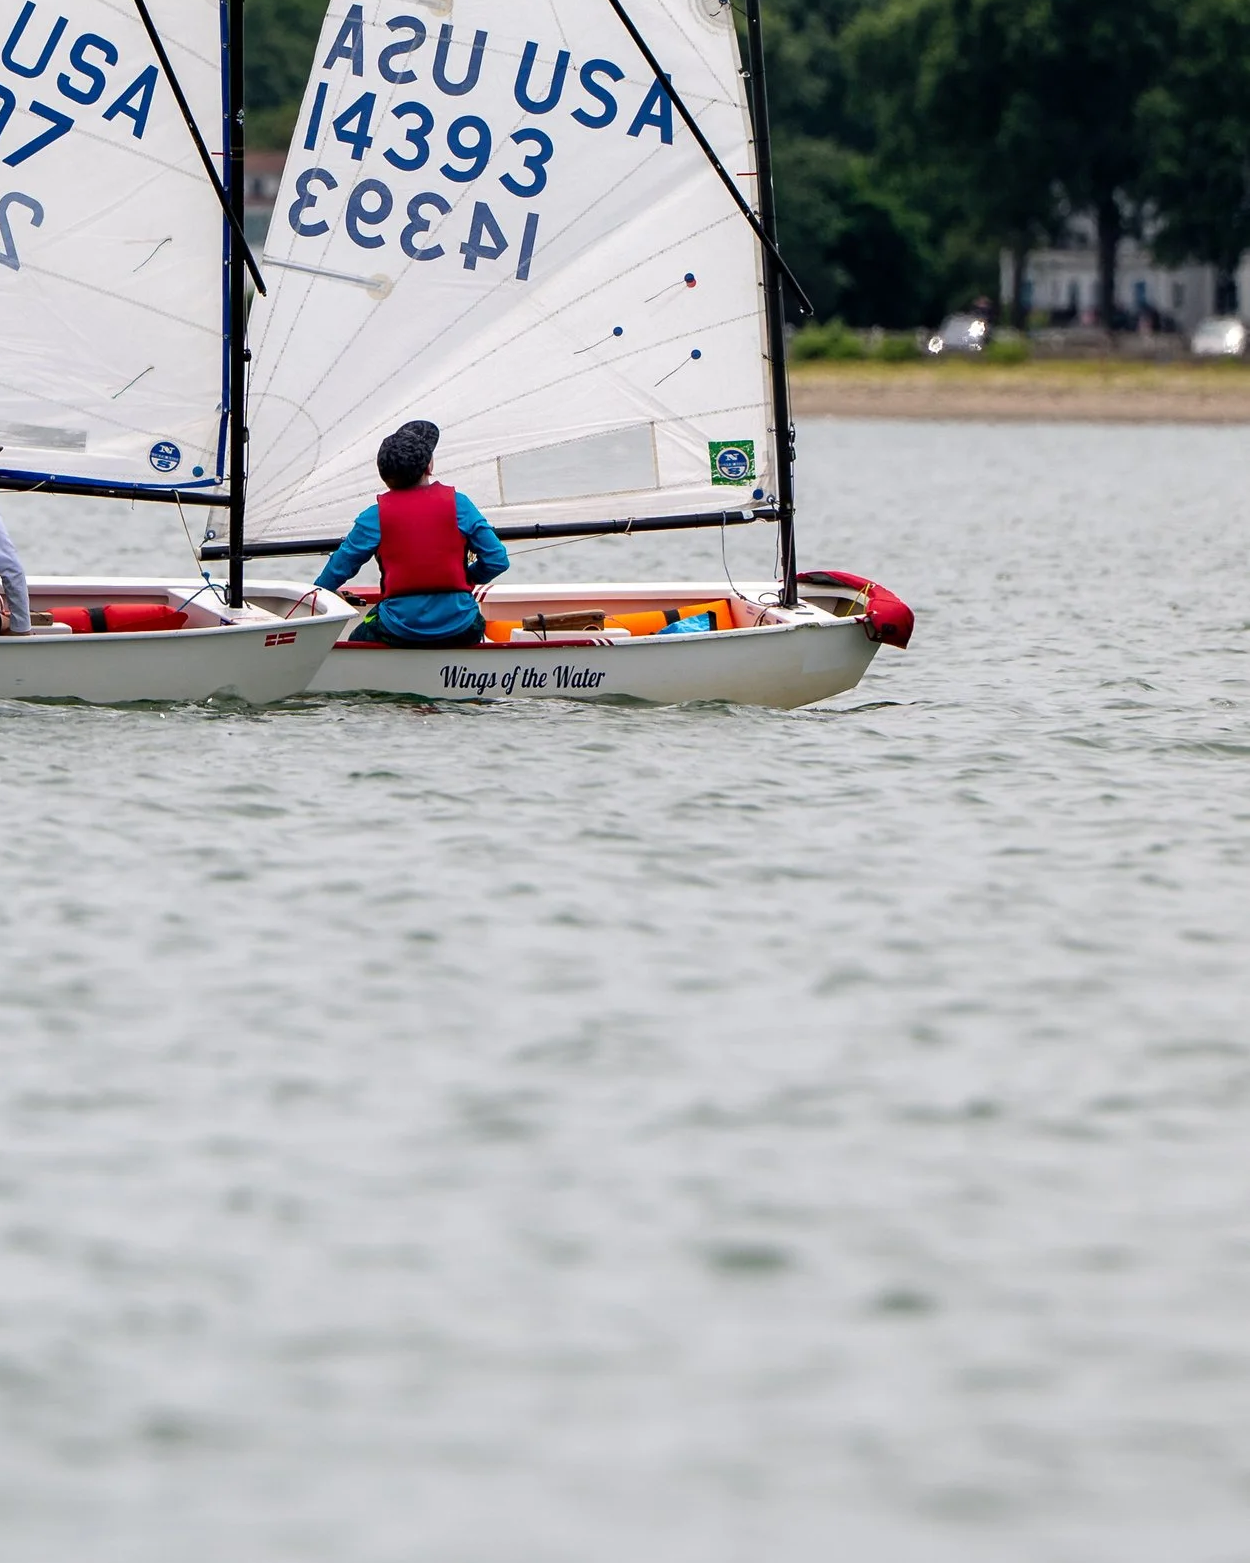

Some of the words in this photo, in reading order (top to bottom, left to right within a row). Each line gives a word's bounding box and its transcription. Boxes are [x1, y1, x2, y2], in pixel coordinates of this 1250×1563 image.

[1, 0, 160, 140] USA
[514, 40, 674, 146] USA
[303, 81, 555, 198] 14393
[439, 665, 497, 695] Wings
[501, 665, 521, 695] of
[521, 667, 547, 688] the
[552, 665, 606, 688] Water
